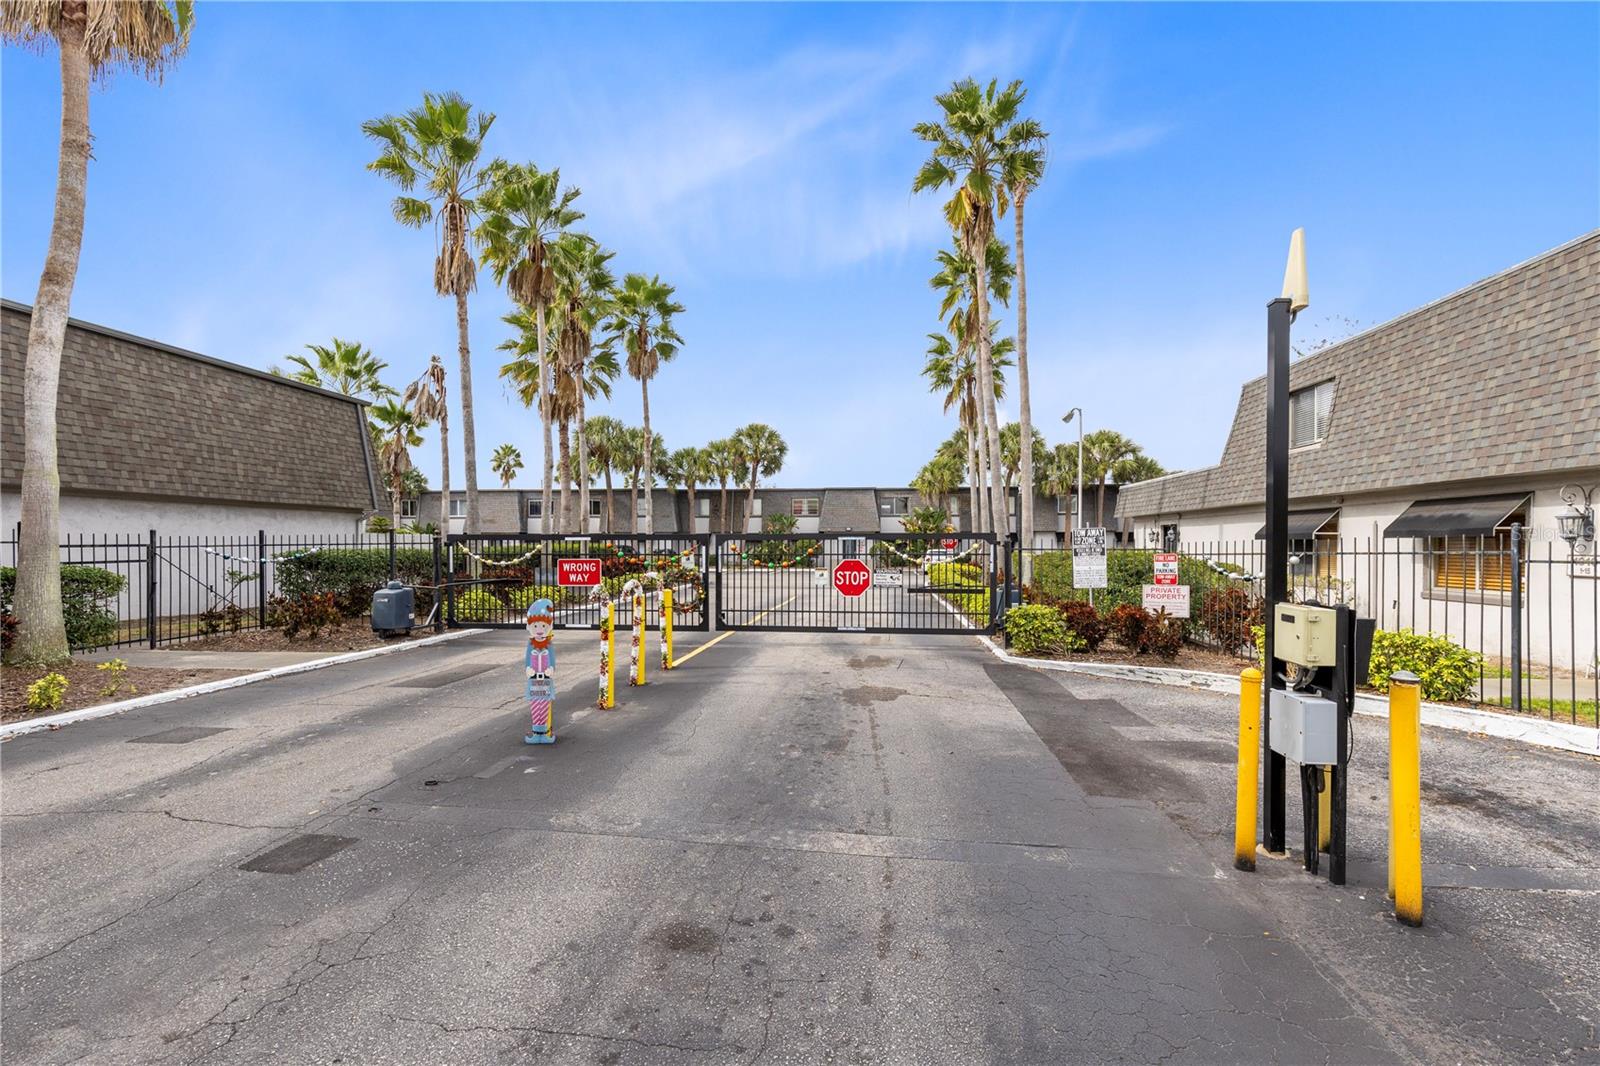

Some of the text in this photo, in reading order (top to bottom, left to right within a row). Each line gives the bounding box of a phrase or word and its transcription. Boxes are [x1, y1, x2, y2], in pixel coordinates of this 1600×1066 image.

[1074, 529, 1086, 537] TOW
[1081, 537, 1097, 545] ZONE
[562, 562, 597, 572] WRONG
[569, 573, 590, 582] WAY
[836, 571, 868, 585] STOP
